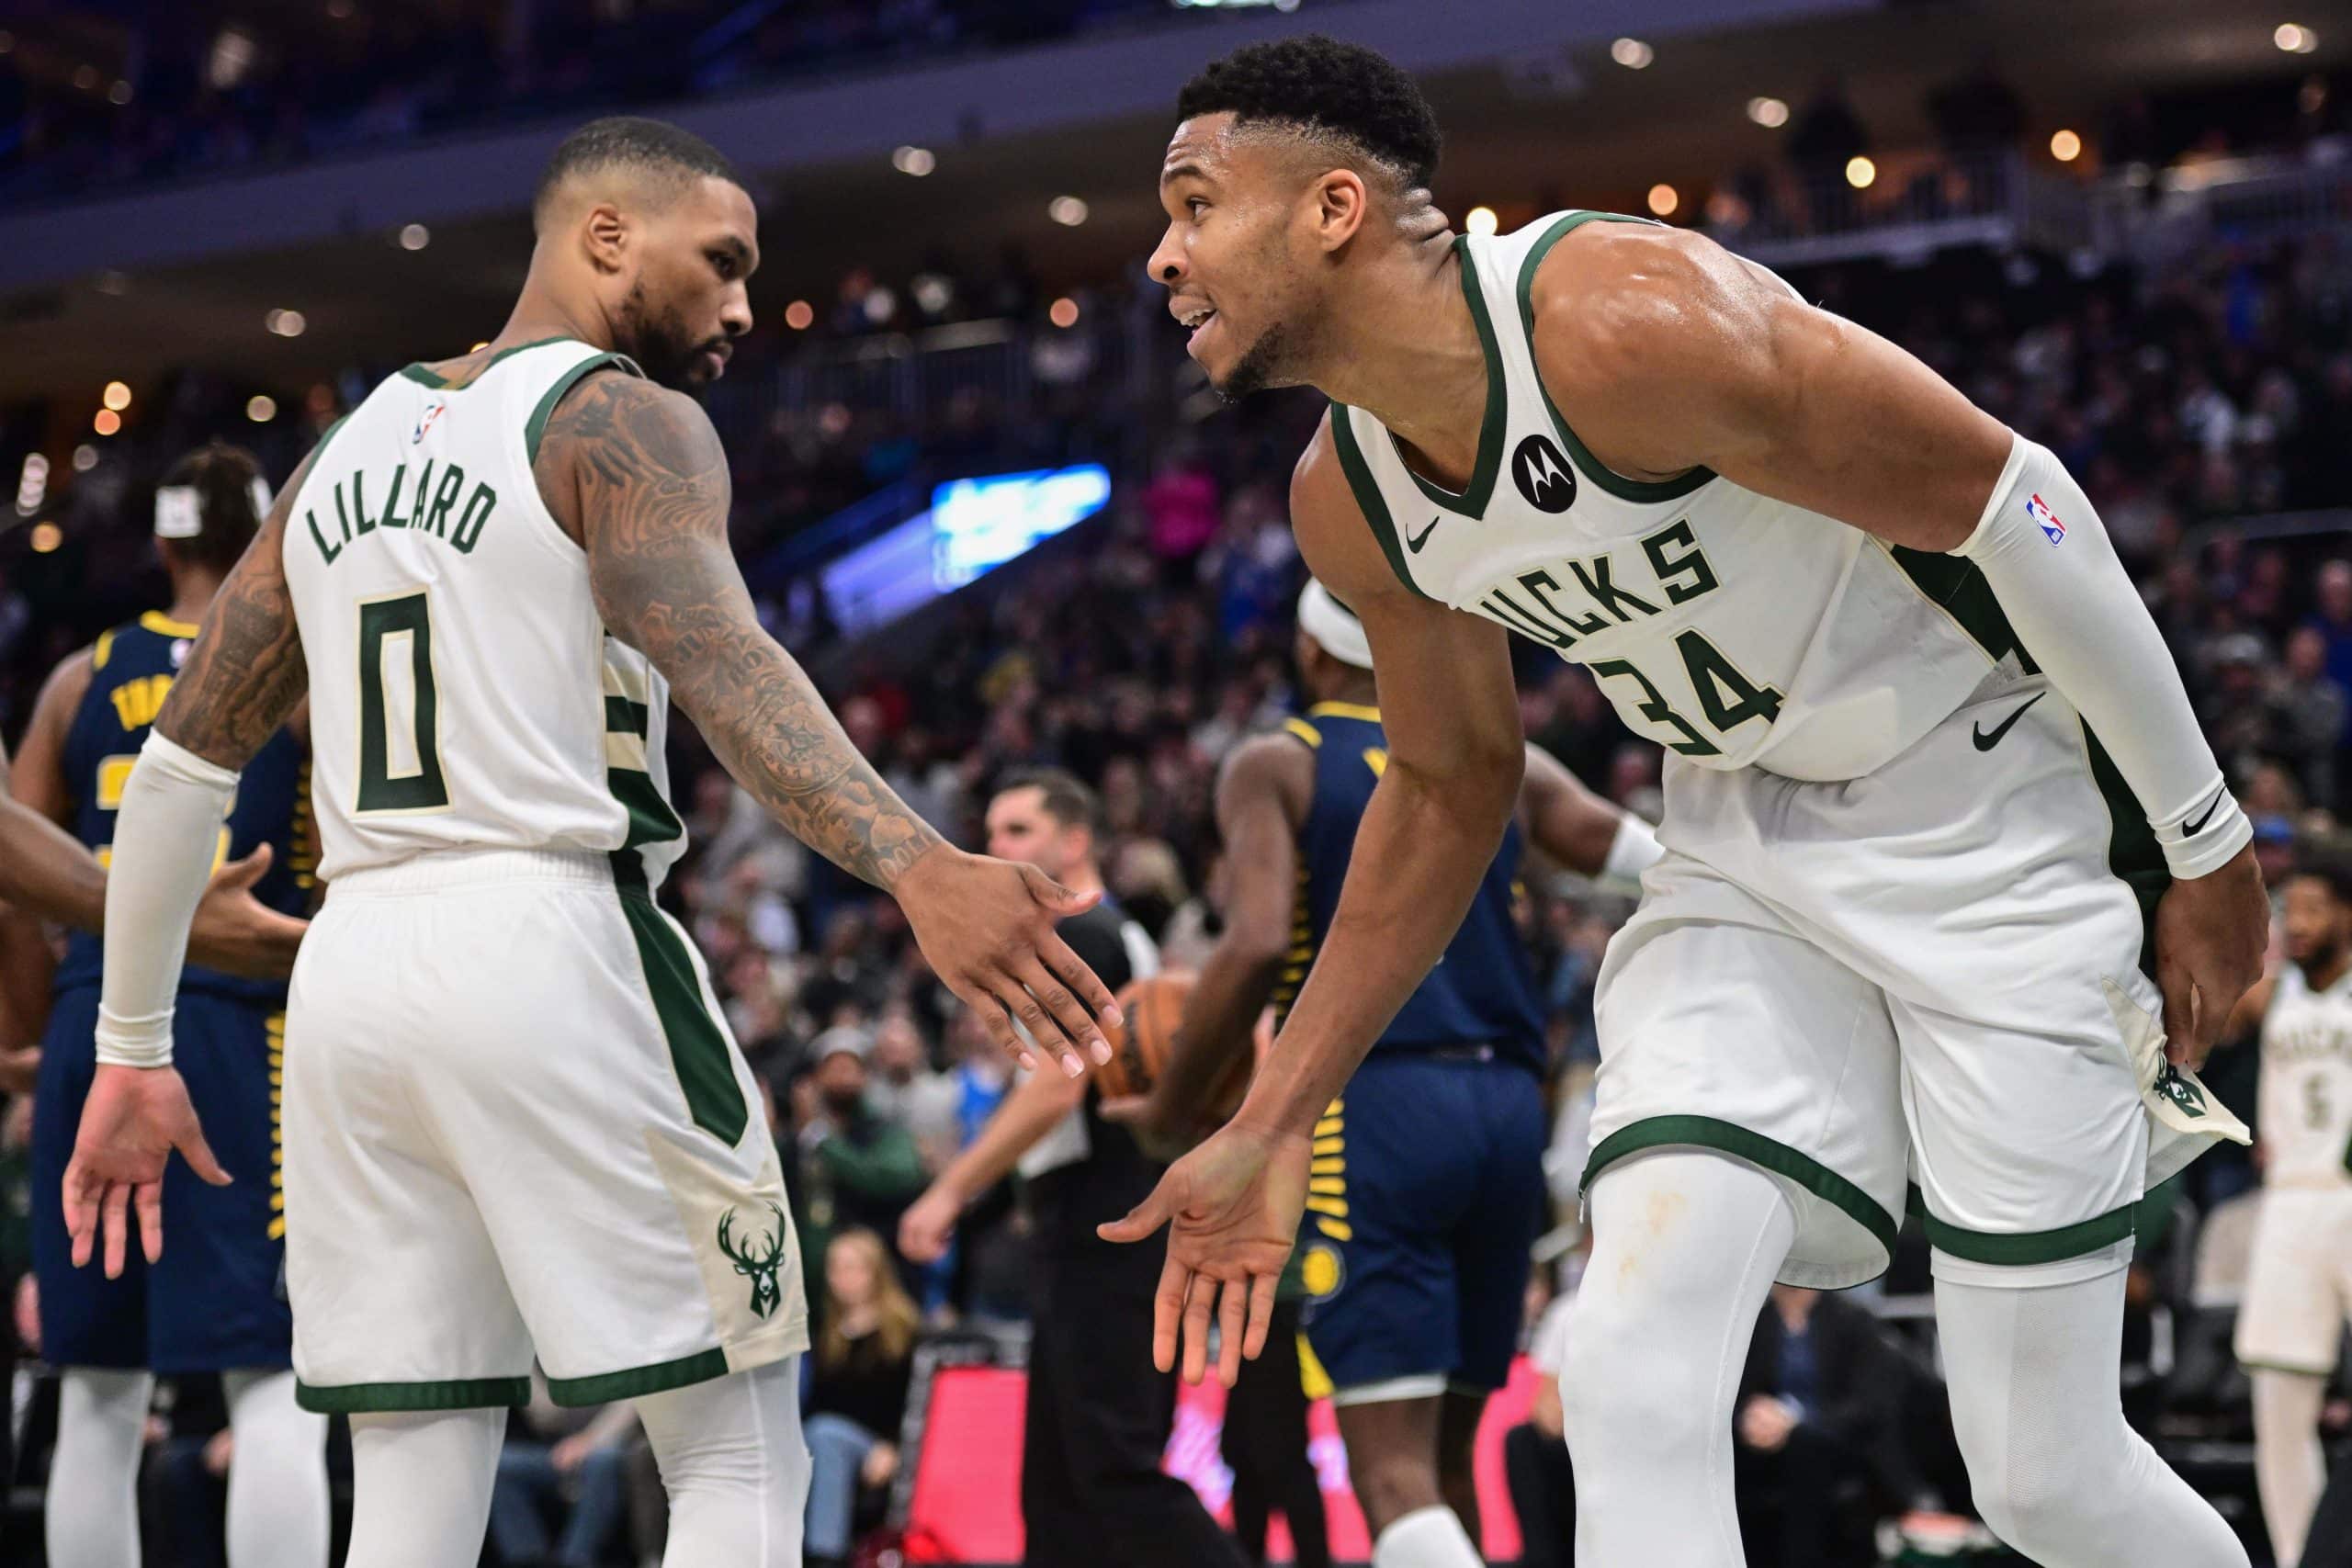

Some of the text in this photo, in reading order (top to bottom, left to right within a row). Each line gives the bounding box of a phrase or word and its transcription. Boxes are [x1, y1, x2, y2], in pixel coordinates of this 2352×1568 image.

[305, 457, 498, 567] LILLARD
[1476, 513, 1724, 650] UCKS
[354, 587, 453, 815] 0
[1588, 626, 1786, 757] 34
